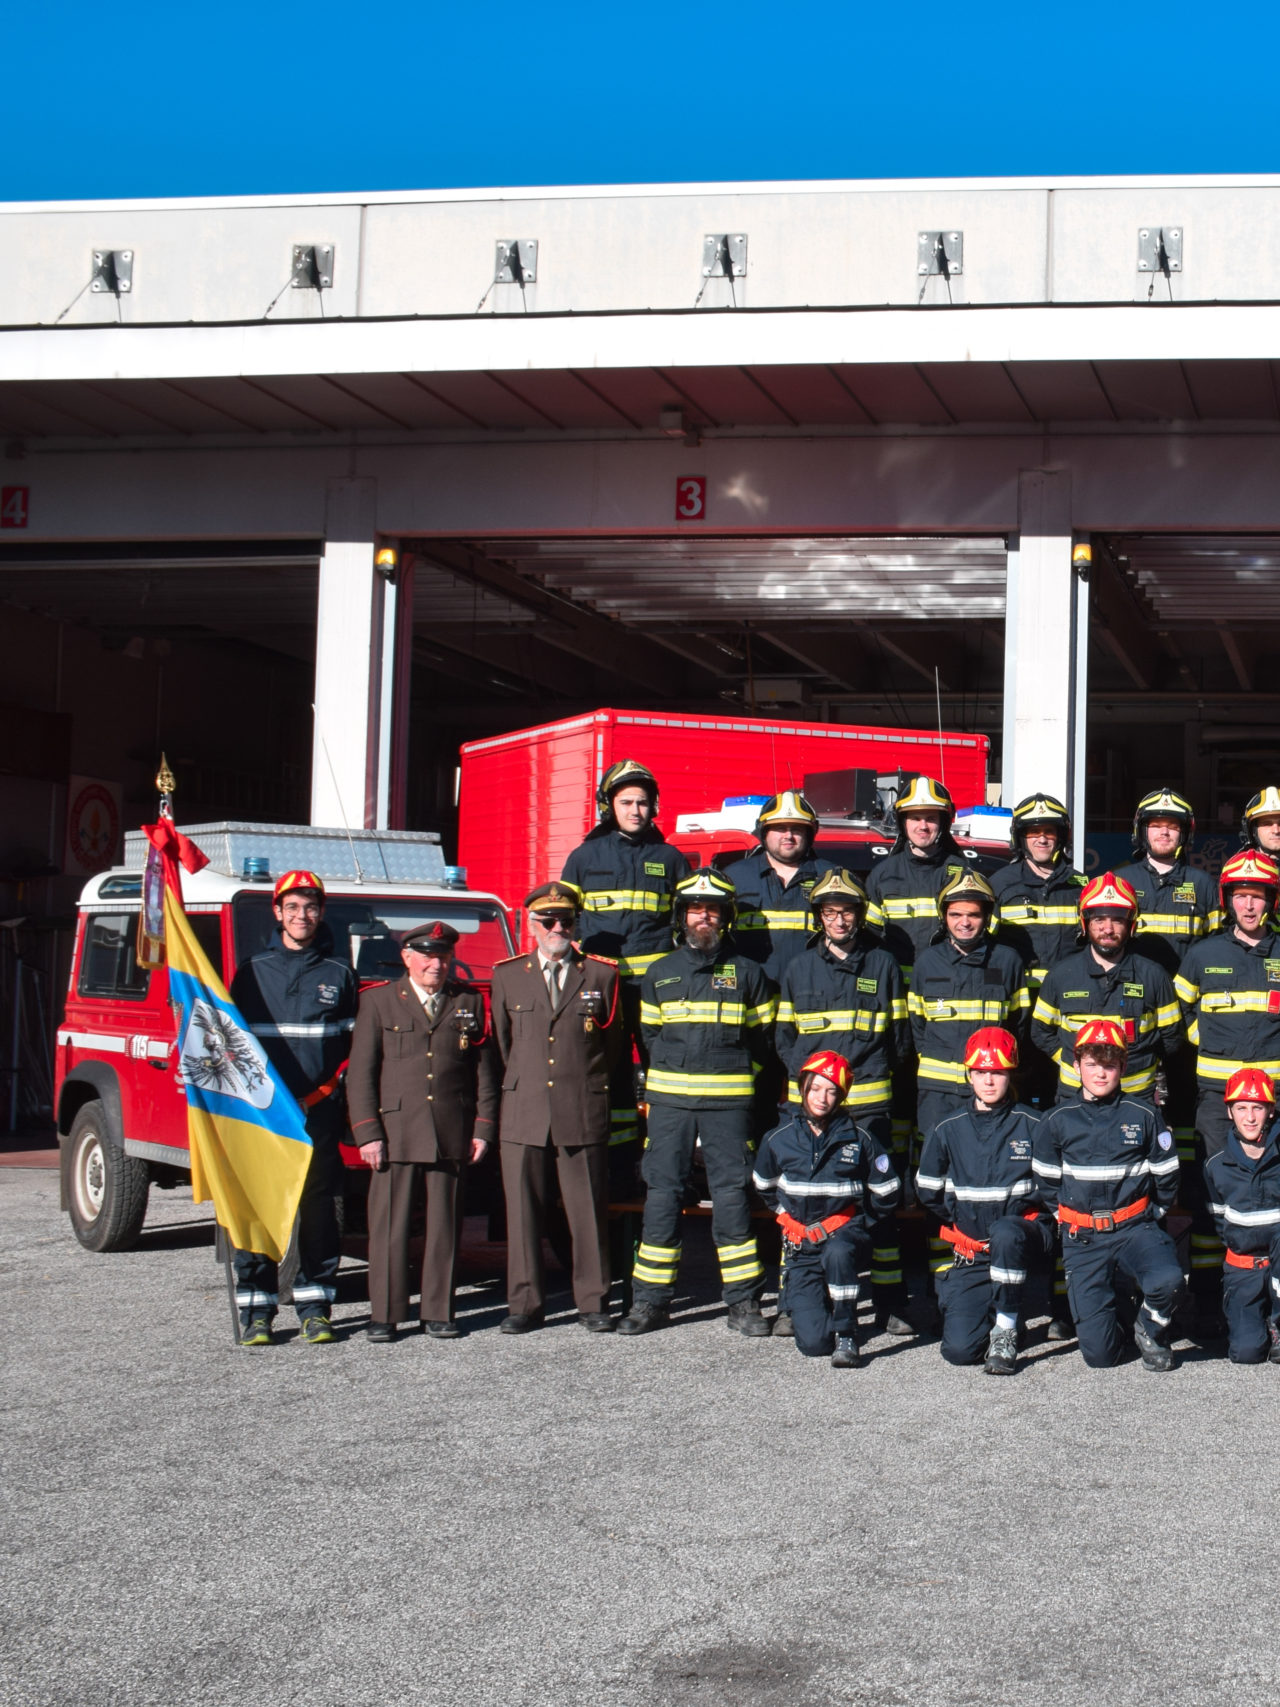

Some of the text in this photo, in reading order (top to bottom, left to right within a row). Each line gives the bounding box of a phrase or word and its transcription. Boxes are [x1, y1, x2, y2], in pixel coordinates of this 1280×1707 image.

[3, 489, 26, 524] 4
[679, 480, 702, 516] 3
[132, 1034, 149, 1059] 115
